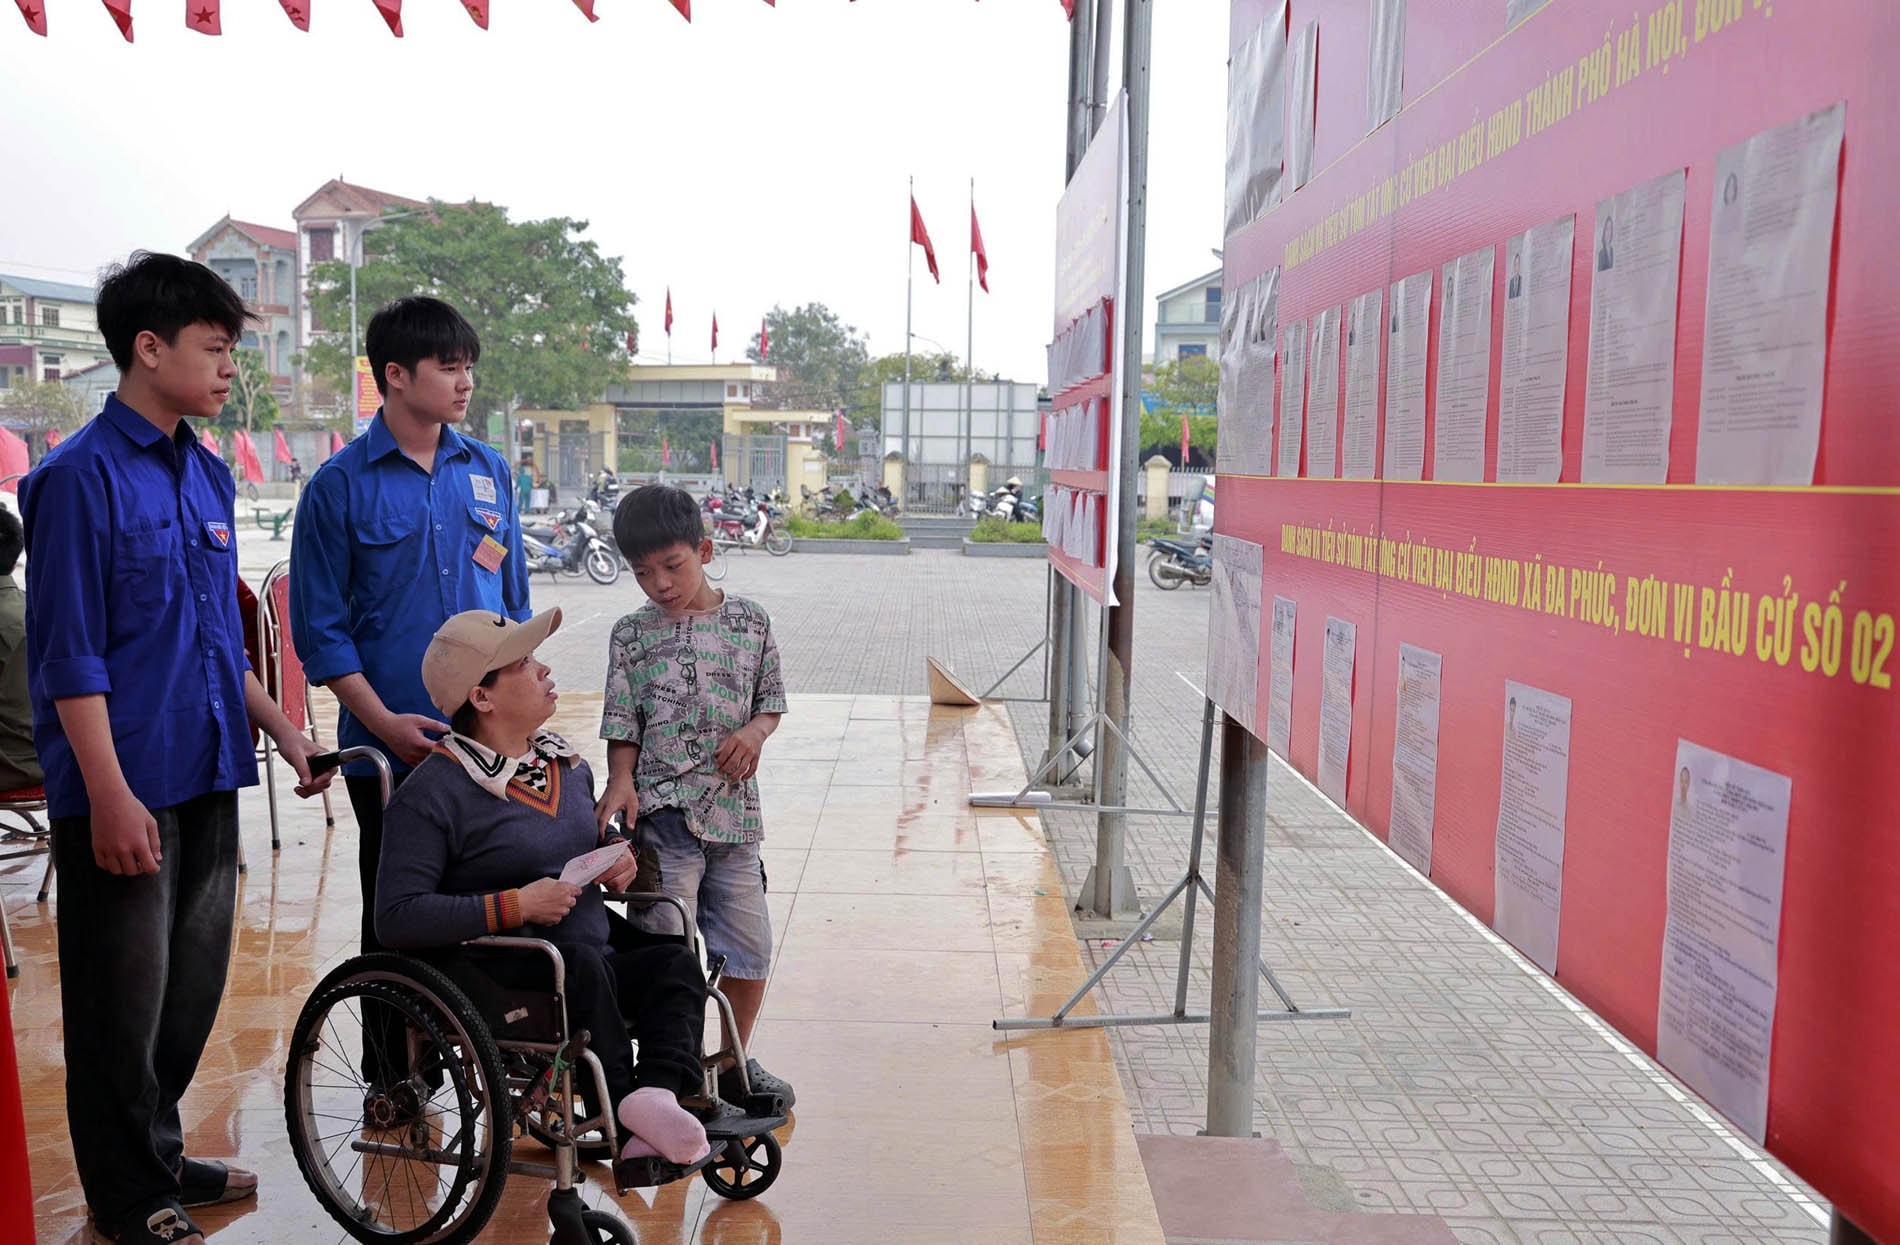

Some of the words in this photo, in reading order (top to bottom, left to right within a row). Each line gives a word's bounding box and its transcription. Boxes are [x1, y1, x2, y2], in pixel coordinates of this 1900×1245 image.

[1414, 147, 1436, 199] VIÊN
[1438, 139, 1457, 193] ĐẠI
[1457, 106, 1485, 176] BIỂU
[1487, 98, 1522, 161] HĐND
[1526, 64, 1574, 139] THÀNH
[1577, 18, 1615, 109] PHỐ
[1616, 11, 1640, 88] HÀ
[1322, 517, 1336, 563] TIỂU
[1337, 521, 1348, 566] SỬ
[1347, 528, 1362, 570] TÓM
[1379, 531, 1396, 578] ỨNG
[1398, 529, 1412, 581] CỬ
[1412, 537, 1434, 586] VIÊN
[1435, 548, 1454, 600] ĐẠI
[1455, 536, 1482, 599] BIỂU
[1484, 556, 1520, 606] HĐND
[1522, 553, 1542, 611] XÃ
[1545, 564, 1565, 617] ĐA
[1569, 560, 1620, 636] PHÚC,
[1625, 574, 1668, 640] ĐƠN
[1673, 583, 1695, 659] VỊ
[1698, 567, 1750, 657] BẦU
[1756, 574, 1799, 666] CỬ
[1801, 580, 1847, 678] SỐ
[1851, 610, 1895, 689] 02
[686, 615, 694, 644] MATCHIN
[695, 622, 761, 651] wisdom
[699, 651, 735, 673] will
[707, 680, 738, 703] you
